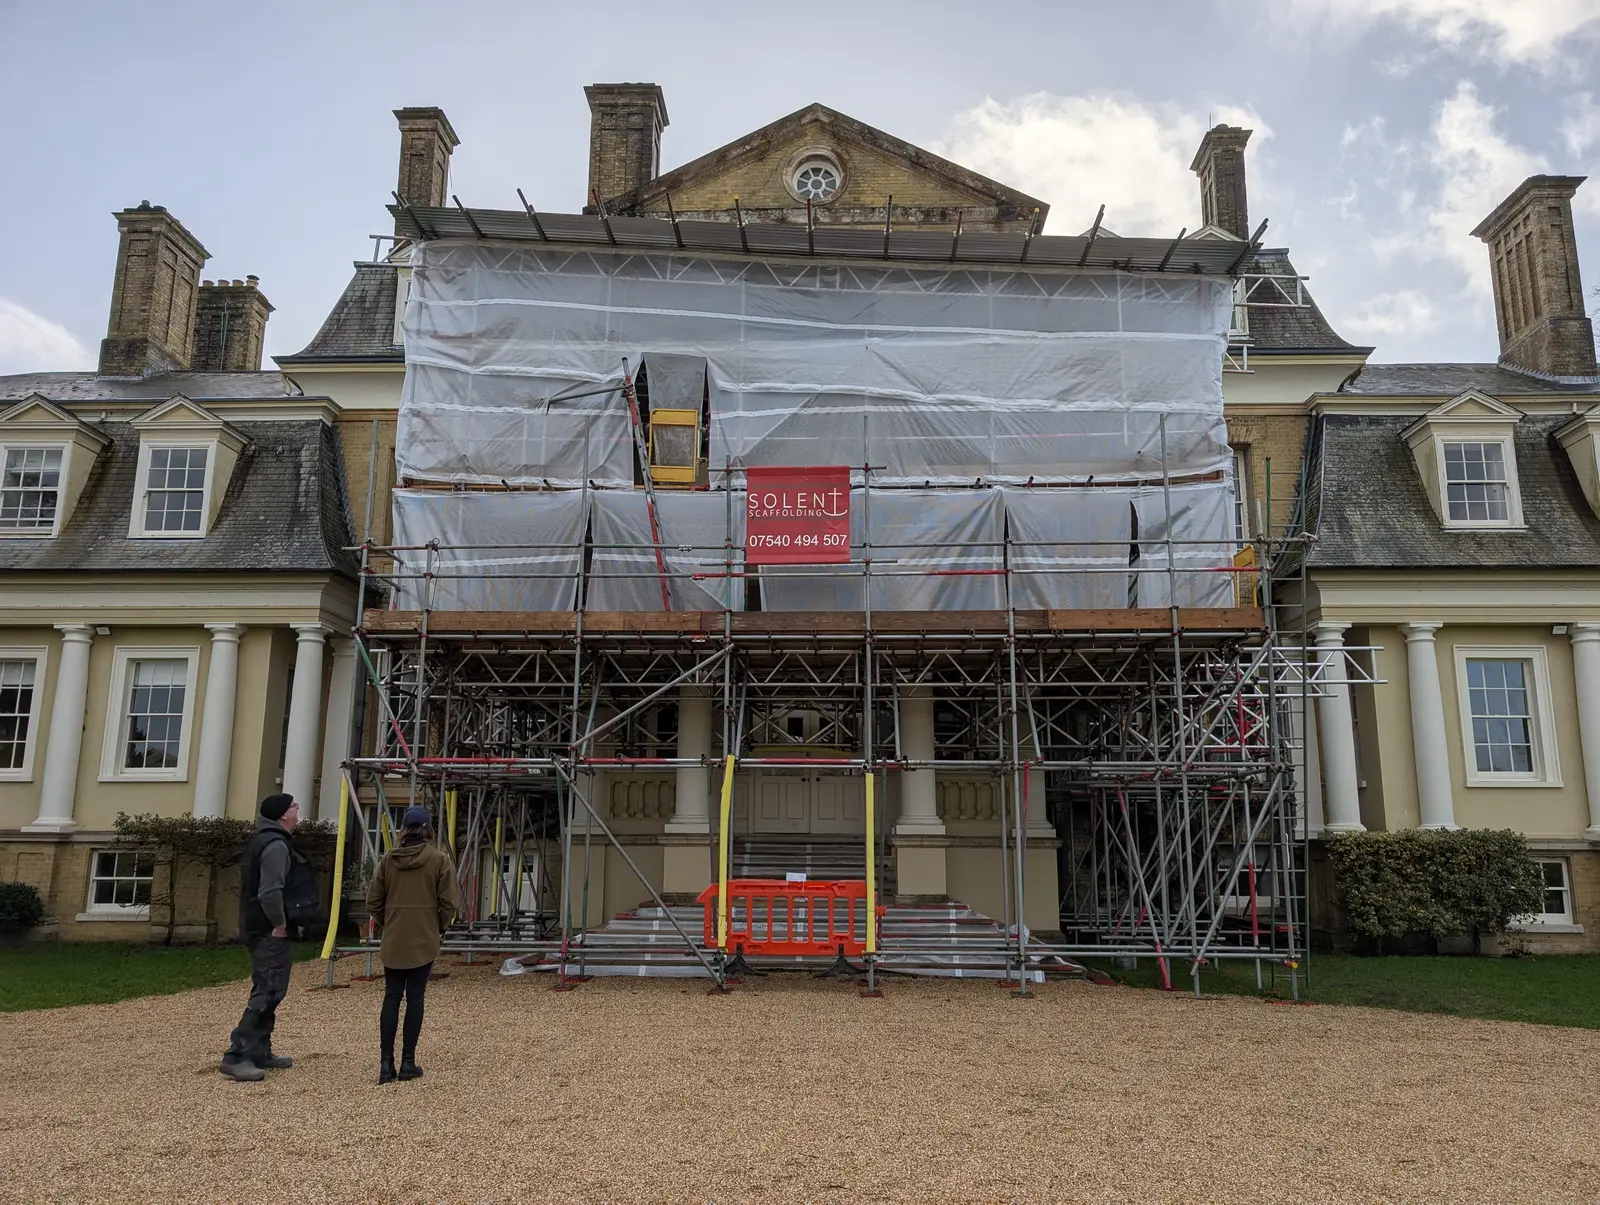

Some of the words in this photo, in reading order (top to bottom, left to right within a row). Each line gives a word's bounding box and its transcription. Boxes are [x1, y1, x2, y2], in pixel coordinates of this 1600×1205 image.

[748, 508, 822, 517] SCAFFOLDING
[749, 534, 791, 547] 07540
[794, 534, 819, 547] 494
[823, 534, 848, 546] 507
